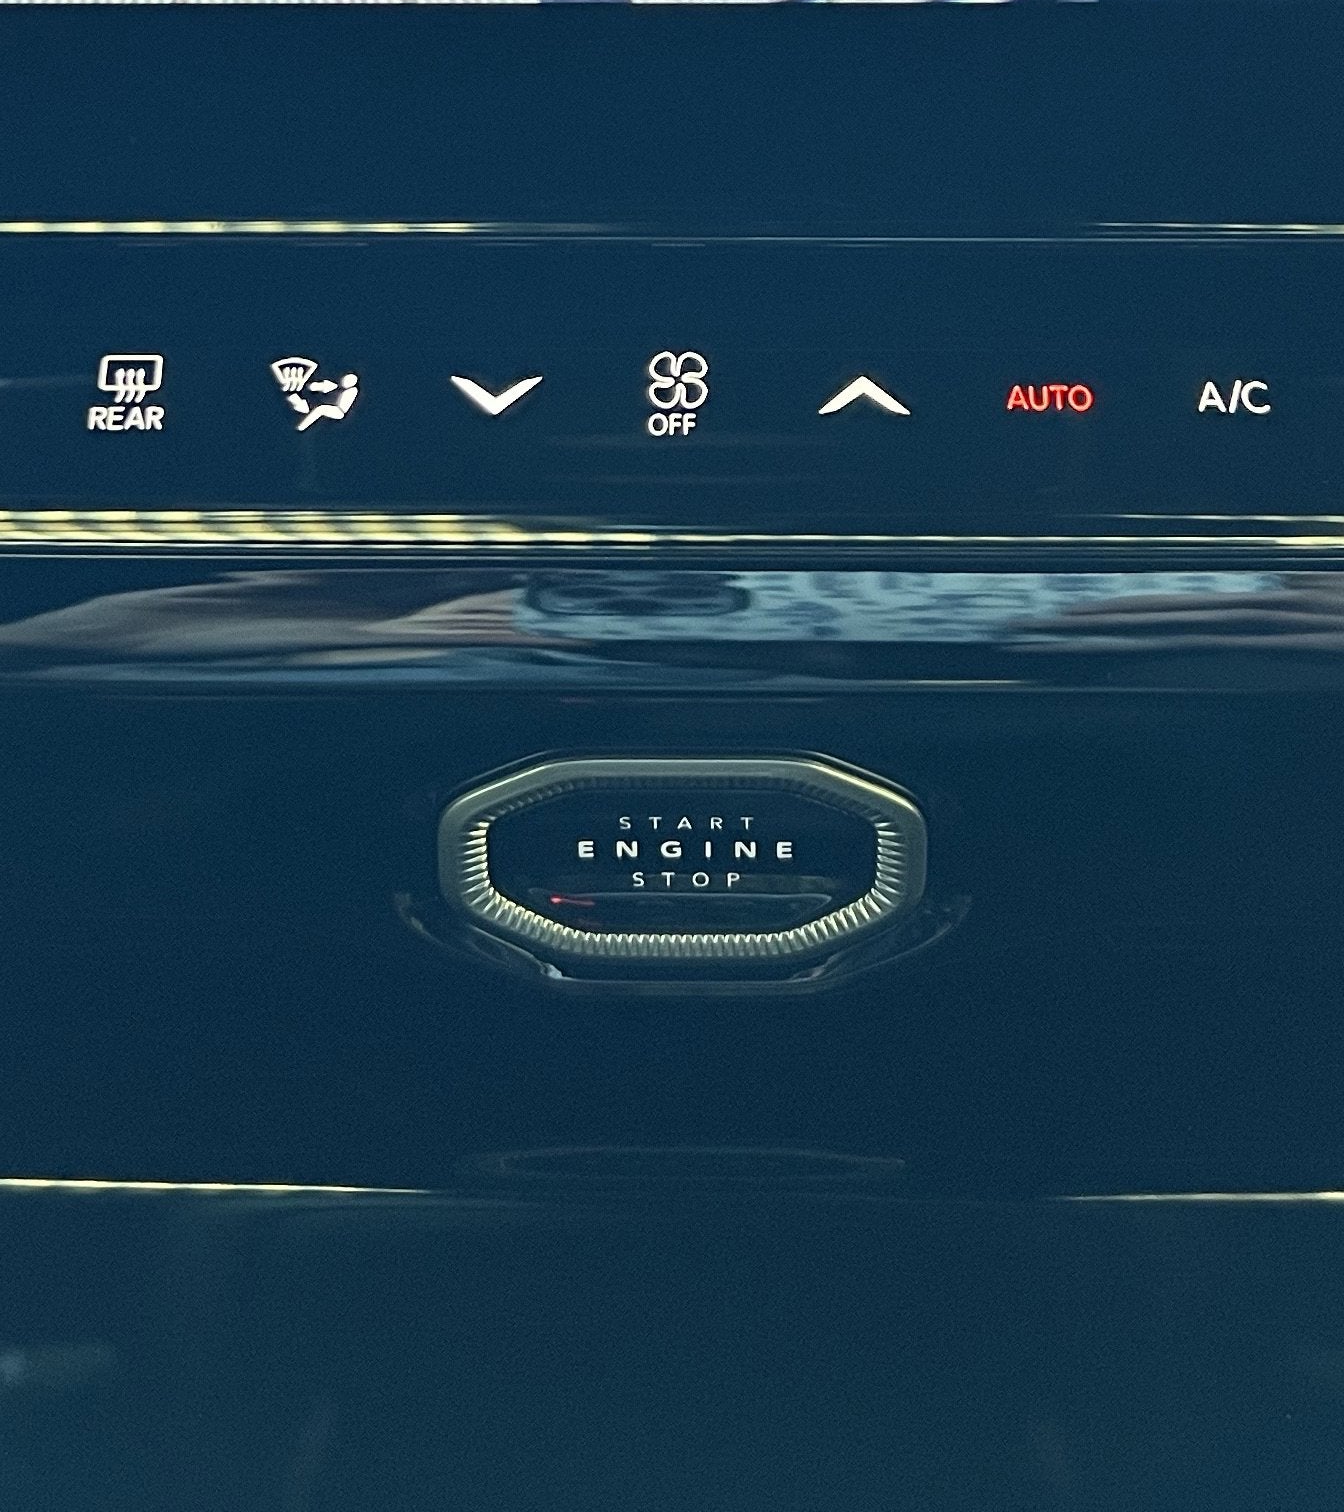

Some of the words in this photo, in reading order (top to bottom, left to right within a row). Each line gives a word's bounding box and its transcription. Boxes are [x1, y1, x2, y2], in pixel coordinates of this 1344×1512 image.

[1006, 384, 1094, 412] AUTO
[1198, 380, 1271, 415] A/C
[88, 406, 165, 431] REAR
[648, 412, 696, 436] OFF
[619, 816, 754, 830] START
[578, 840, 793, 859] ENGINE
[632, 871, 740, 888] STOP
